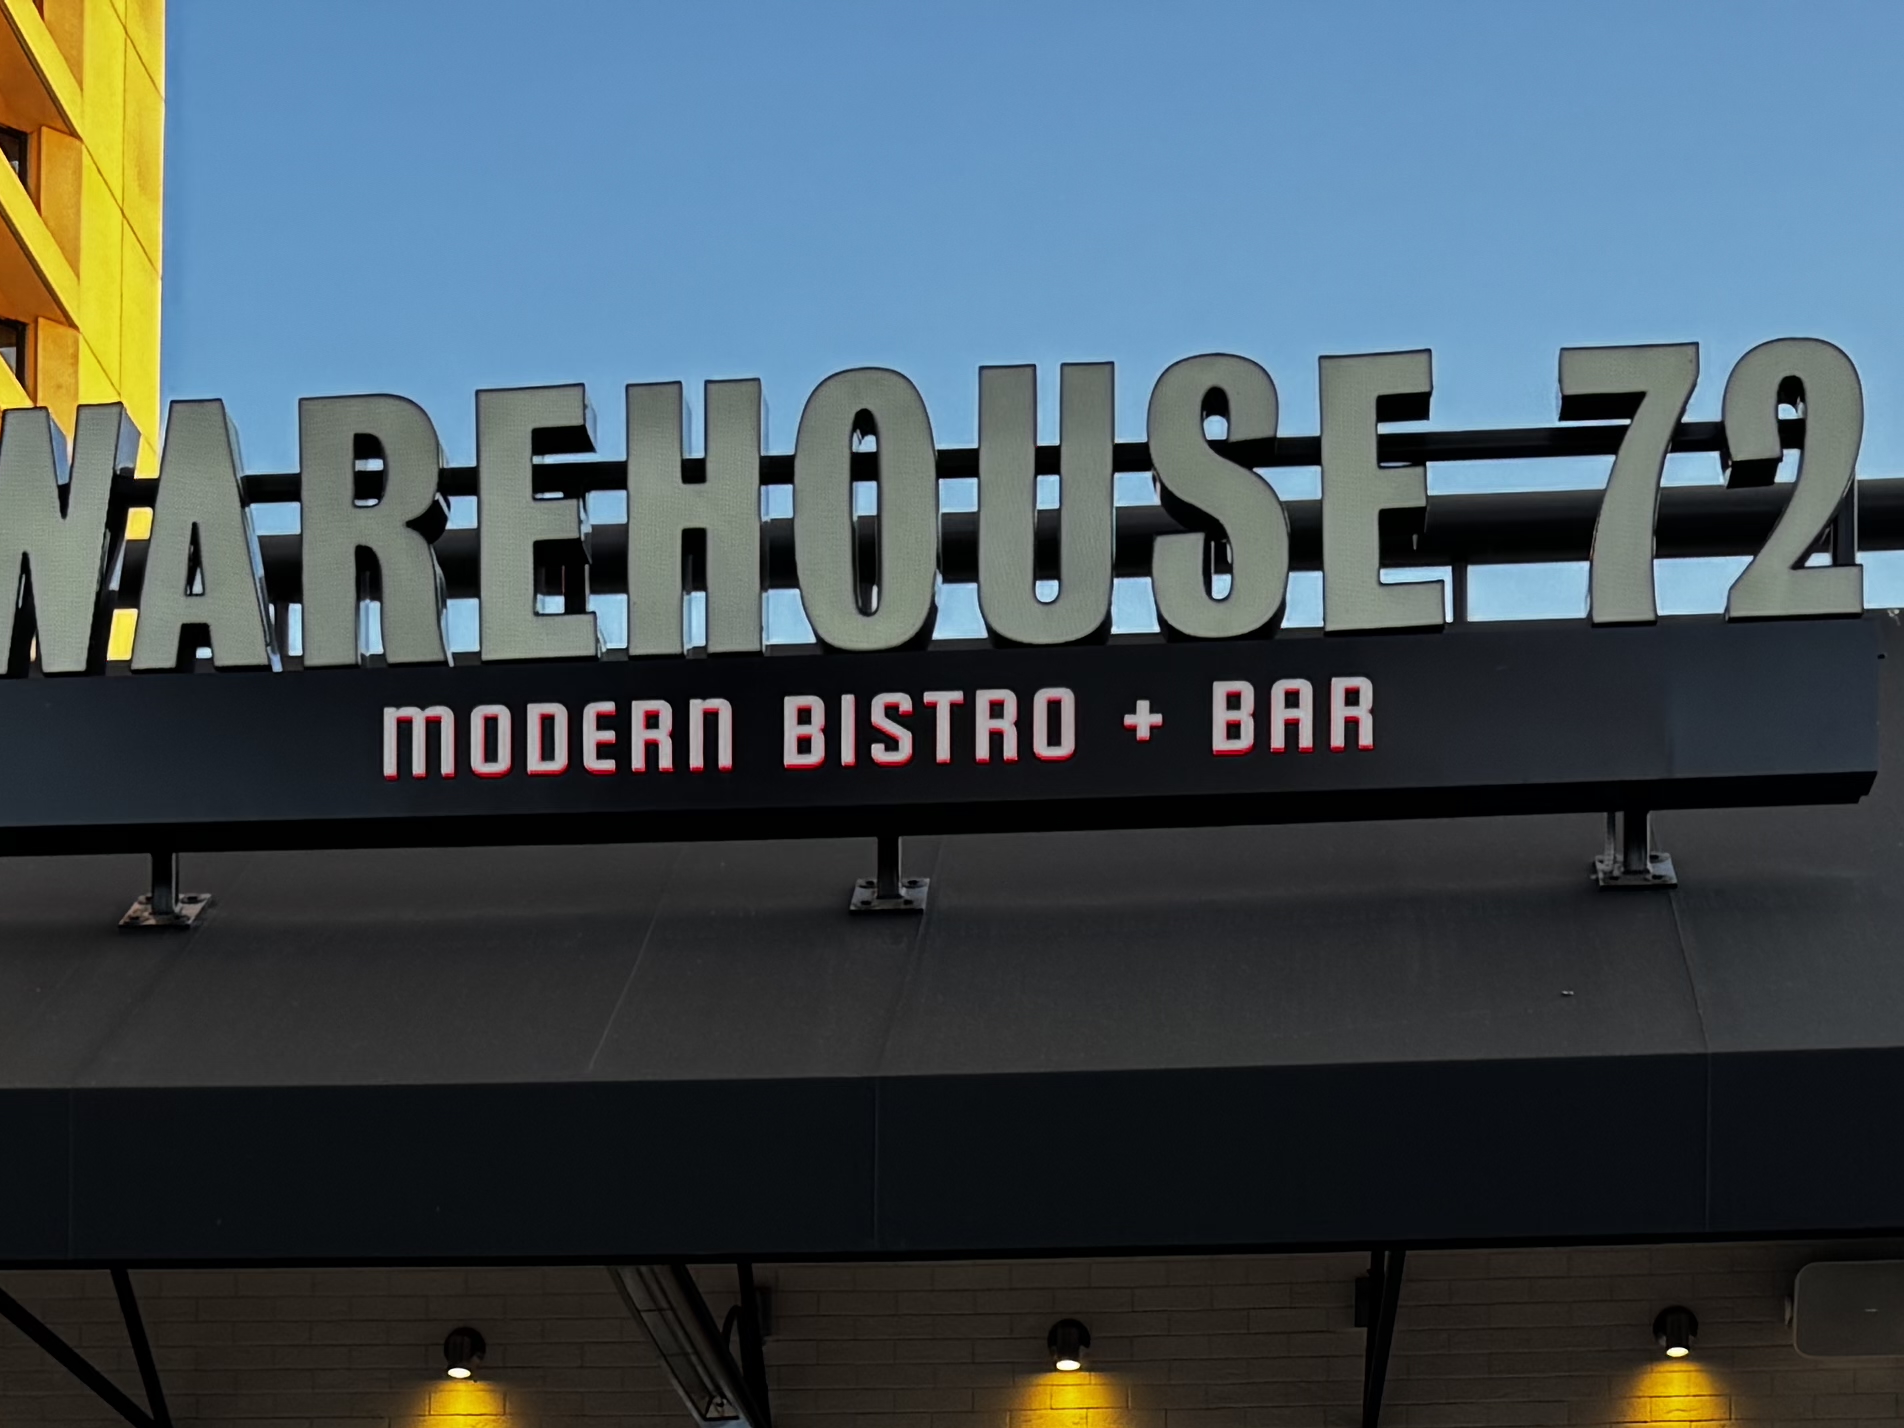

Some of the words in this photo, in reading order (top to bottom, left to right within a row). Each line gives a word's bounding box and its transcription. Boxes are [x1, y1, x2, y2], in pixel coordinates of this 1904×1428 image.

[1558, 336, 1865, 626] 72
[382, 697, 734, 779] MODERN
[783, 686, 1077, 769] BISTRO
[1210, 675, 1375, 755] BAR
